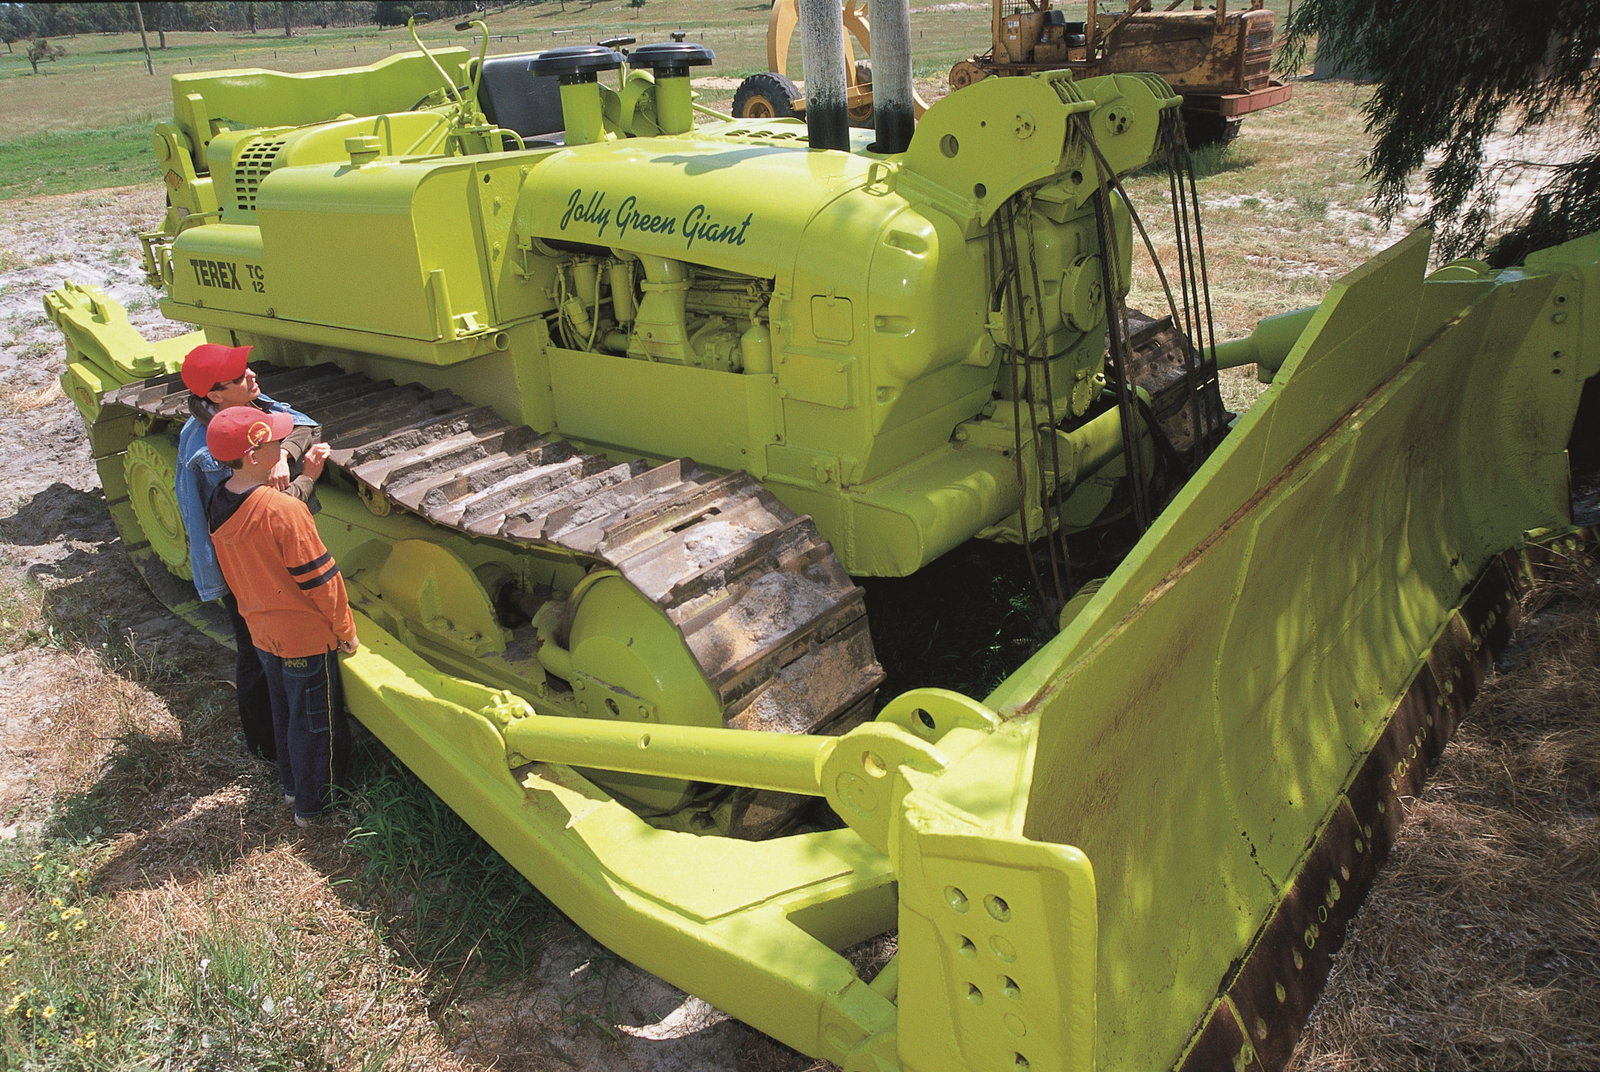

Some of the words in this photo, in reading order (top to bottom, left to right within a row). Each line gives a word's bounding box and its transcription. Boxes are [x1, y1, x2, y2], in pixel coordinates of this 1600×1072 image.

[560, 188, 612, 239] Jolly
[616, 195, 677, 239] Green
[683, 204, 753, 251] Giant
[189, 258, 243, 291] TEREX
[245, 264, 265, 280] TC
[251, 281, 266, 294] 12
